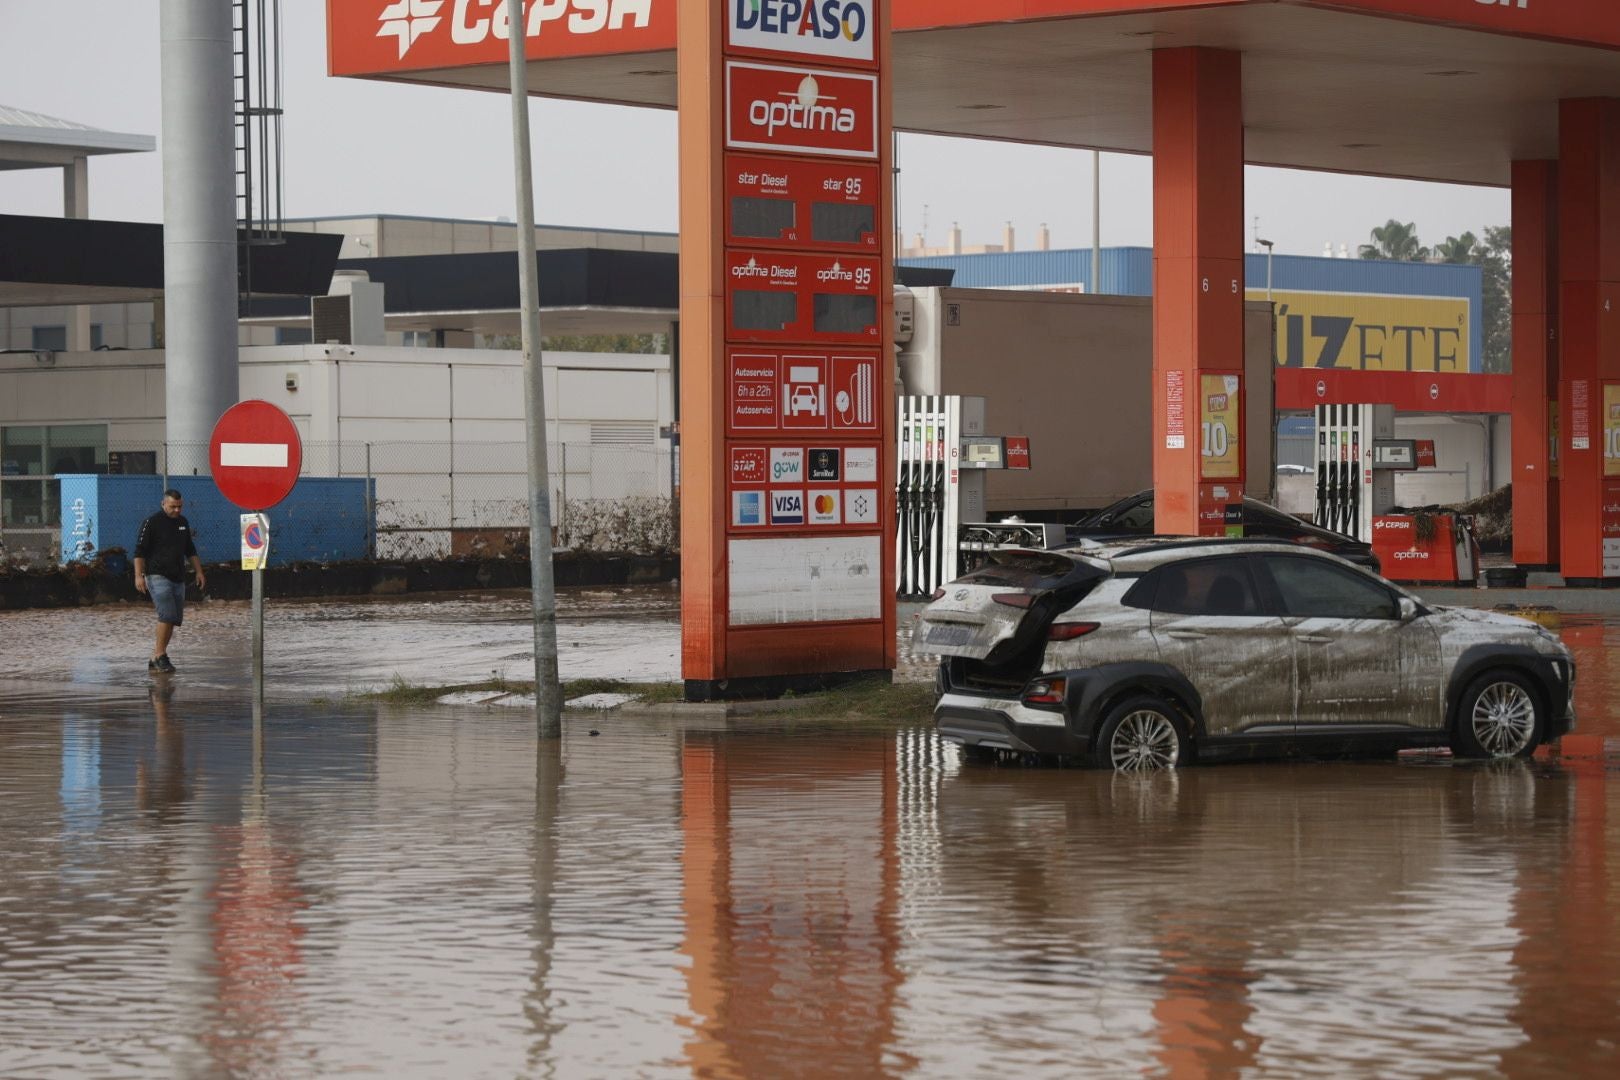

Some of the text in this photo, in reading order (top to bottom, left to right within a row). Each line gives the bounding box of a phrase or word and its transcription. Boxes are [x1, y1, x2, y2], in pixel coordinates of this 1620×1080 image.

[736, 0, 866, 42] DEPASO
[750, 99, 855, 136] optima
[738, 171, 788, 187] star Diesel
[823, 177, 862, 195] star 95
[732, 265, 798, 279] optima Diesel
[816, 267, 871, 284] optima 95
[1202, 278, 1209, 291] 6
[1231, 279, 1238, 293] 5
[735, 367, 774, 377] Autoservicio
[738, 384, 772, 397] 6h a 22h
[736, 405, 773, 415] Autoservici
[1201, 421, 1228, 457] 10
[951, 447, 958, 458] 6
[1365, 449, 1372, 459] 4
[733, 460, 756, 471] STAR
[774, 496, 801, 512] VISA
[72, 497, 85, 536] hub
[1385, 521, 1410, 529] CEPSA
[1393, 550, 1429, 561] optima
